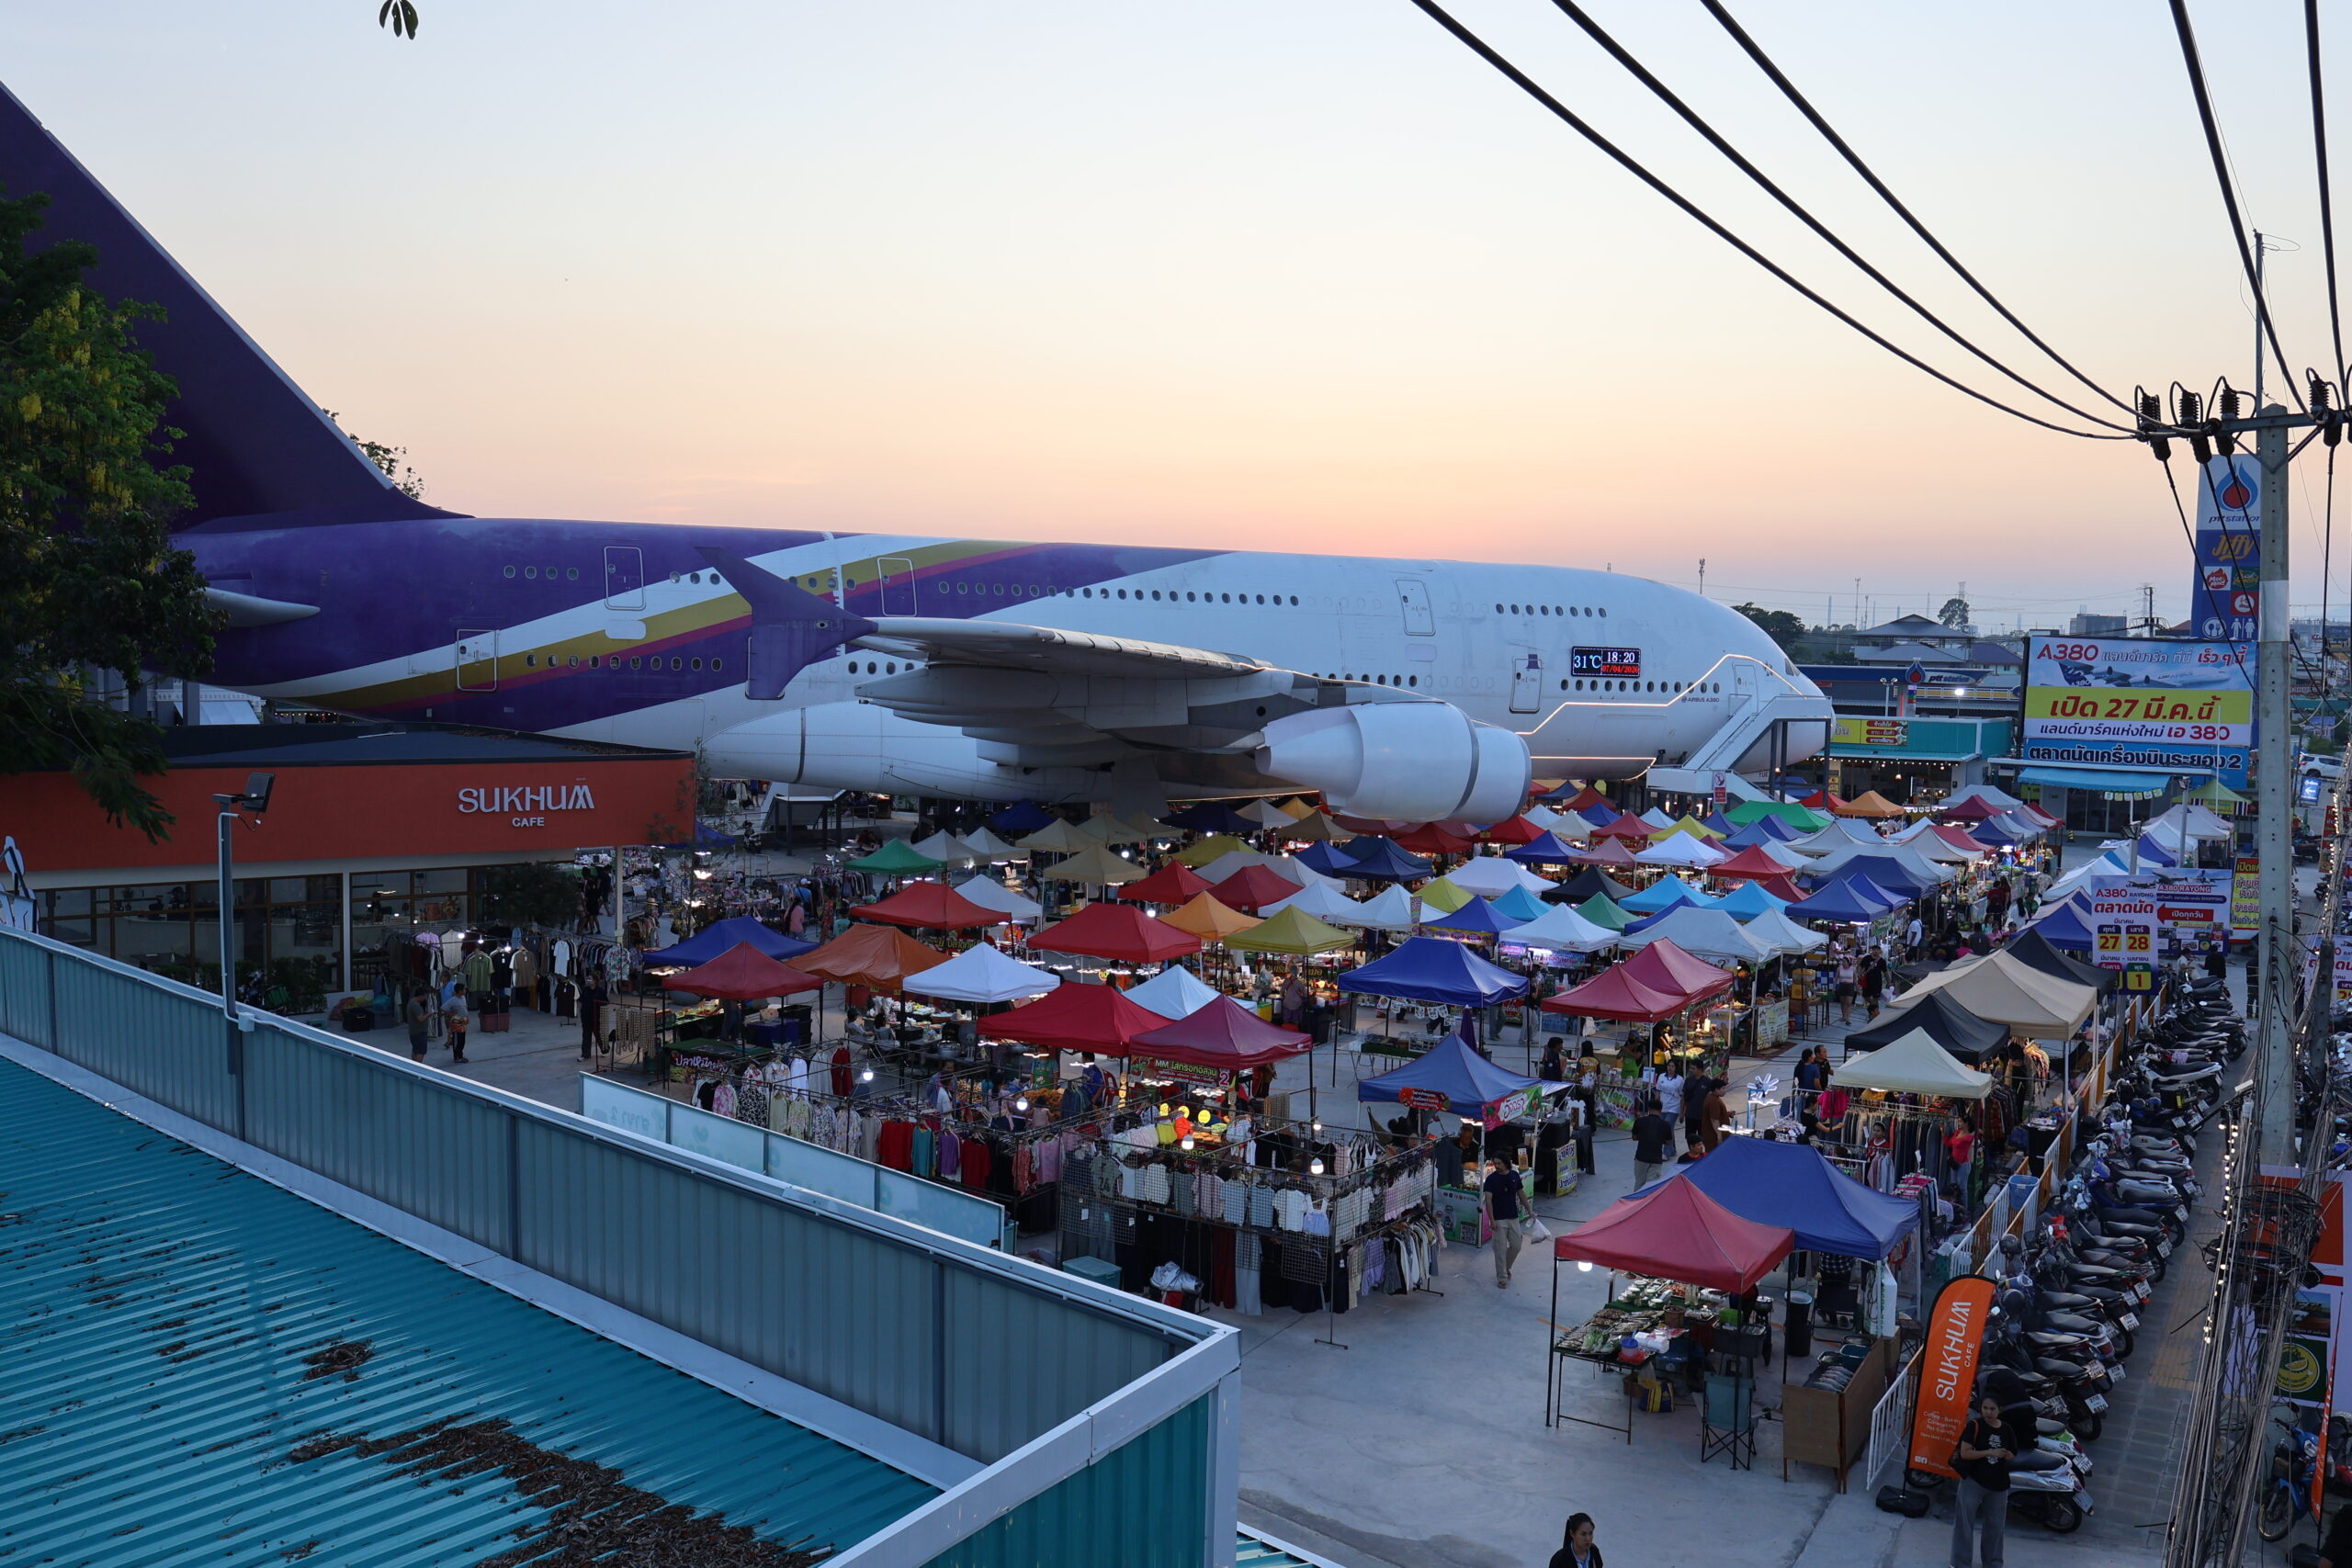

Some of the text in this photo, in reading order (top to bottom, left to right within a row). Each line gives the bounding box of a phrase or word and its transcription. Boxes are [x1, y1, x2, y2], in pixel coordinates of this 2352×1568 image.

[1607, 651, 1635, 663] 18:20
[2037, 644, 2099, 660] A380
[2101, 648, 2168, 663] แลนด์มาร์ค
[2198, 648, 2219, 664] เร็ว
[2050, 695, 2099, 718] เปิด
[2105, 698, 2140, 718] 27
[2041, 722, 2231, 740] แลนด์มาร์คแห่งใหม่ เอ 380
[2228, 754, 2243, 770] 2
[458, 784, 595, 813] SUKHUM
[512, 817, 545, 828] CAFE
[2096, 888, 2128, 898] A380
[2094, 900, 2154, 914] ตลาดนัด
[2171, 910, 2204, 920] เปิดทุกวัน
[2099, 935, 2120, 950] 27
[2128, 936, 2149, 950] 28
[2135, 974, 2143, 987] 1
[1155, 1059, 1170, 1068] MM
[1219, 1072, 1229, 1086] 2
[1936, 1301, 1973, 1402] SUKHUM
[1963, 1342, 1975, 1369] CAFE
